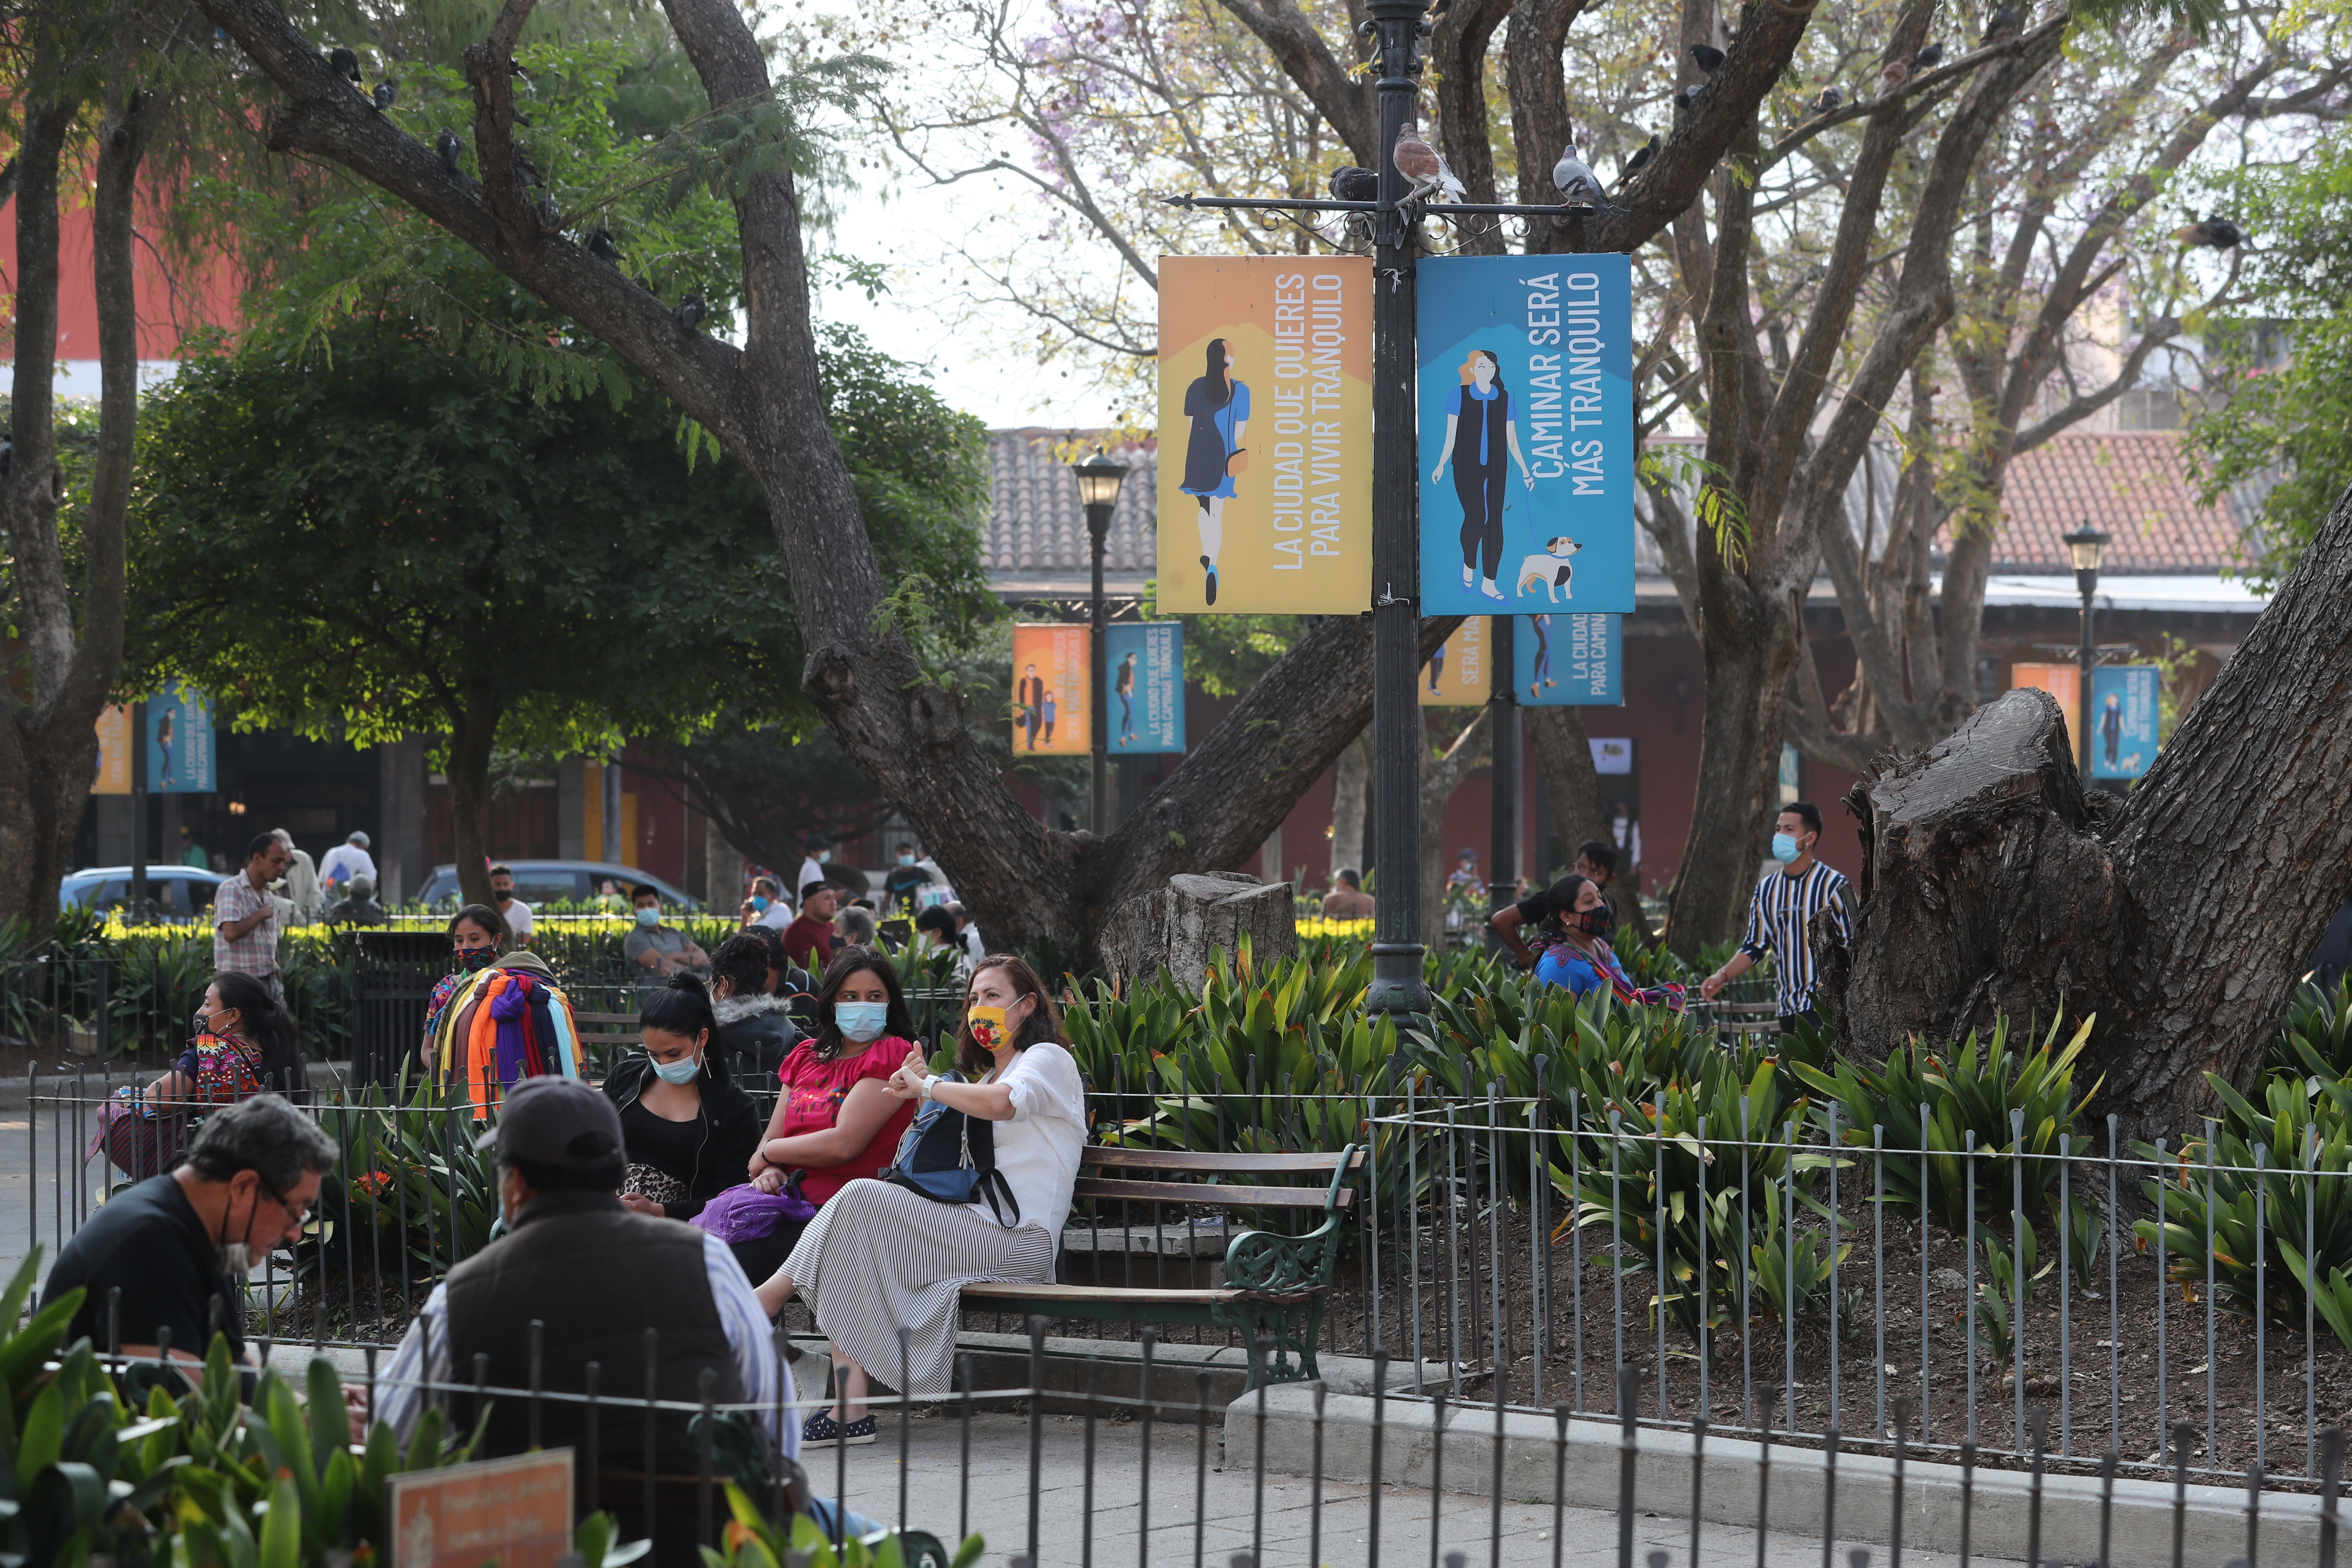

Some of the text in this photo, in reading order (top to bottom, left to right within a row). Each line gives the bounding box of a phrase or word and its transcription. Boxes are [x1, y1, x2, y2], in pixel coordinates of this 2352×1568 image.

[1519, 272, 1564, 478] CAMINAR SERÁ
[1563, 272, 1605, 496] MÁS TRANQUILO
[1273, 274, 1308, 570] LA CIUDAD QUE QUIERES
[1310, 274, 1346, 556] PARA VIVIR TRANQUILO
[1053, 630, 1067, 670] PARQUE
[1054, 672, 1066, 686] AL
[1064, 629, 1082, 740] SERÁ MÁS TRANQUILO
[1146, 628, 1161, 735] LA CIUDAD QUE QUIERES
[1160, 627, 1174, 746] PARA CAMINAR TRANQUILO
[1458, 645, 1479, 685] SERÁ
[1572, 661, 1588, 679] LA
[1590, 660, 1606, 695] PARA
[185, 769, 196, 780] LA
[196, 768, 208, 789] PARA
